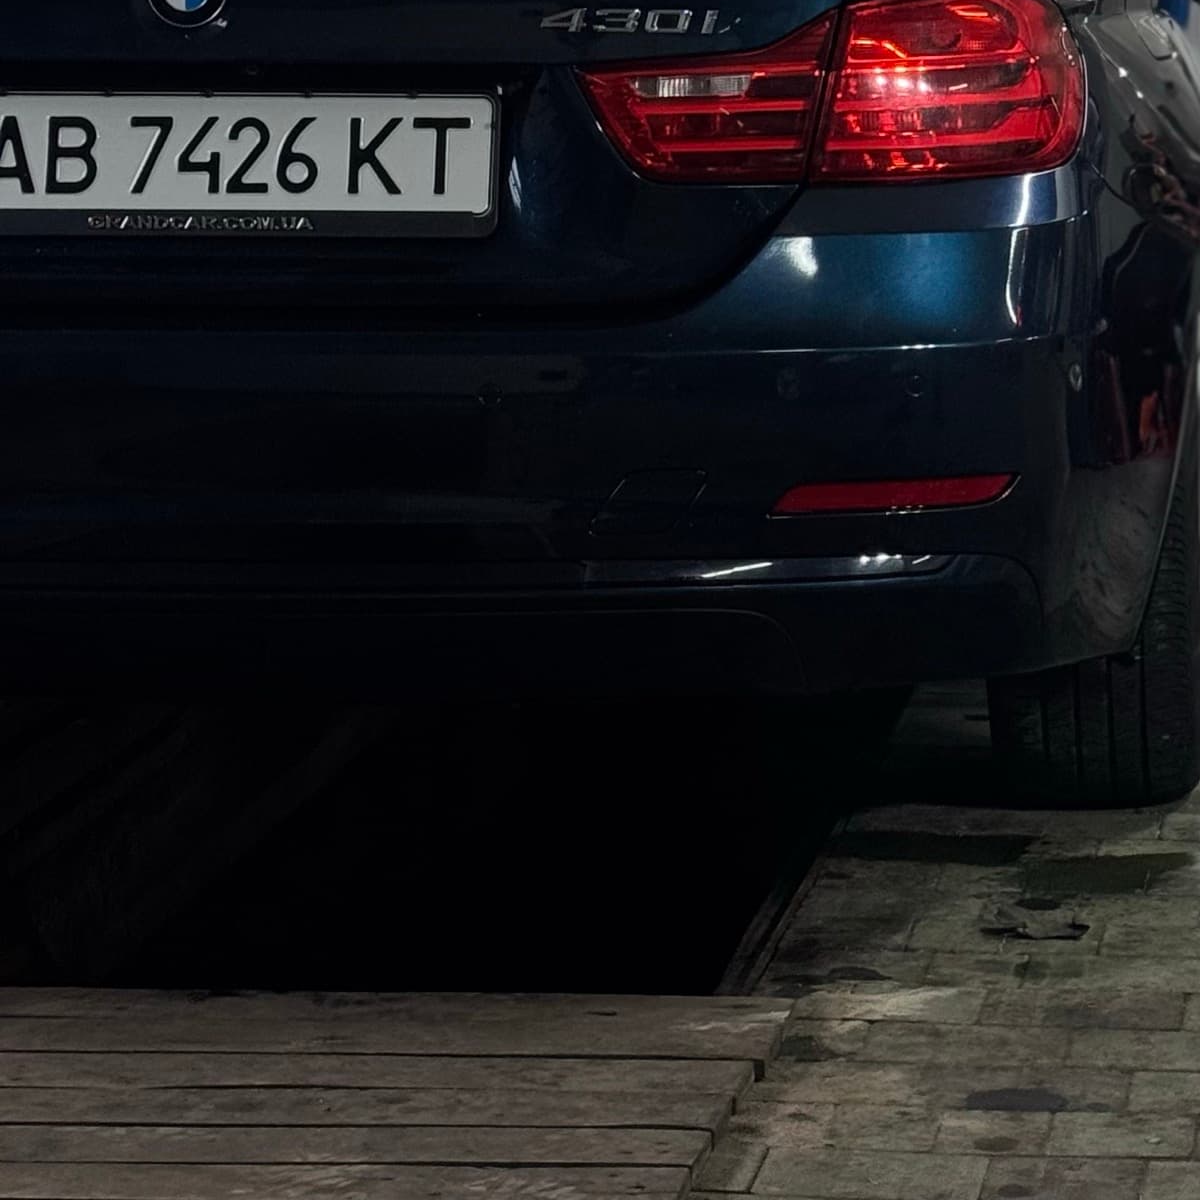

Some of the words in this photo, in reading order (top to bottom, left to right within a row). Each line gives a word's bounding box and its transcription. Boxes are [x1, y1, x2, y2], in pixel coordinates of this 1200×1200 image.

[0, 116, 97, 194] AB
[130, 116, 318, 194] 7426
[347, 116, 472, 195] KT
